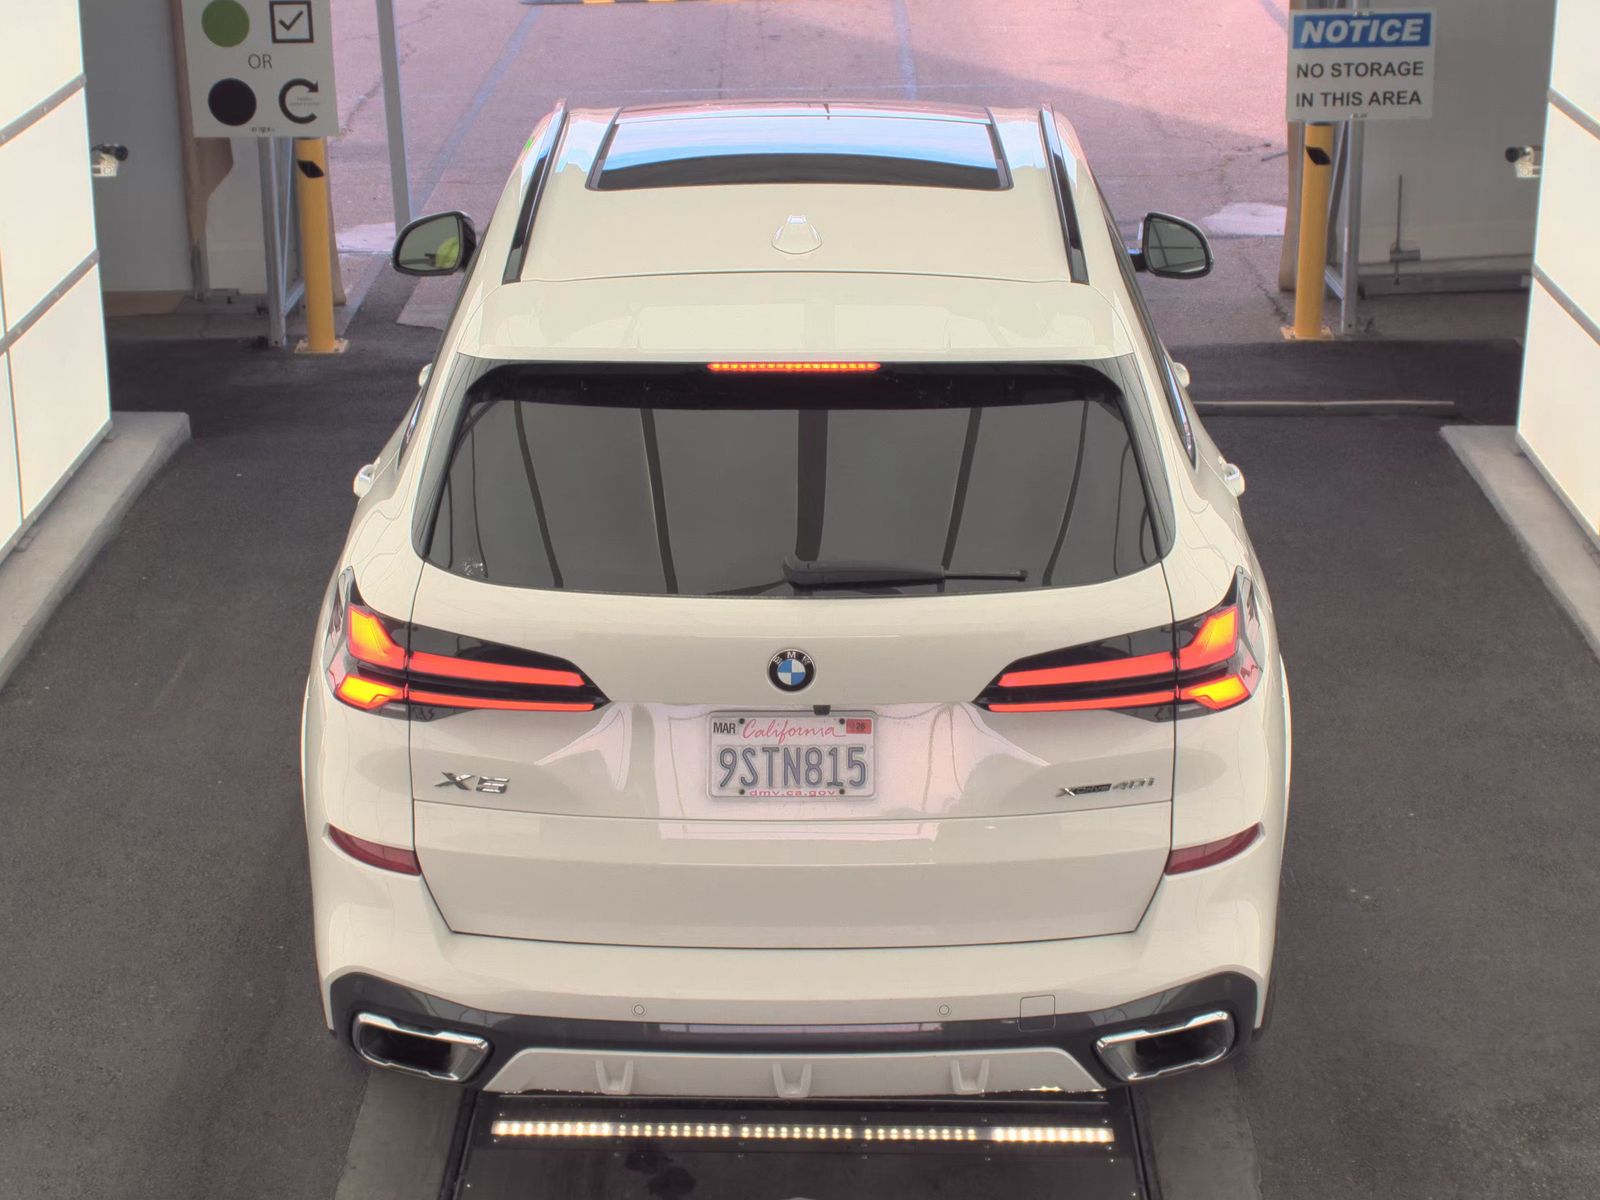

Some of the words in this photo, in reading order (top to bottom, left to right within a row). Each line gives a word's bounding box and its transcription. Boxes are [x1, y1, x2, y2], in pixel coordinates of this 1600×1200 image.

[1300, 18, 1424, 44] NOTICE
[247, 54, 272, 69] OR
[1296, 63, 1324, 78] NO
[1330, 61, 1424, 78] STORAGE
[1296, 93, 1313, 107] IN
[1320, 91, 1362, 107] THIS
[1368, 90, 1422, 106] AREA
[713, 722, 736, 734] MAR
[743, 719, 846, 744] California
[719, 746, 866, 788] 9STN815
[433, 771, 510, 794] X5
[751, 789, 836, 797] dmv.ca.gov
